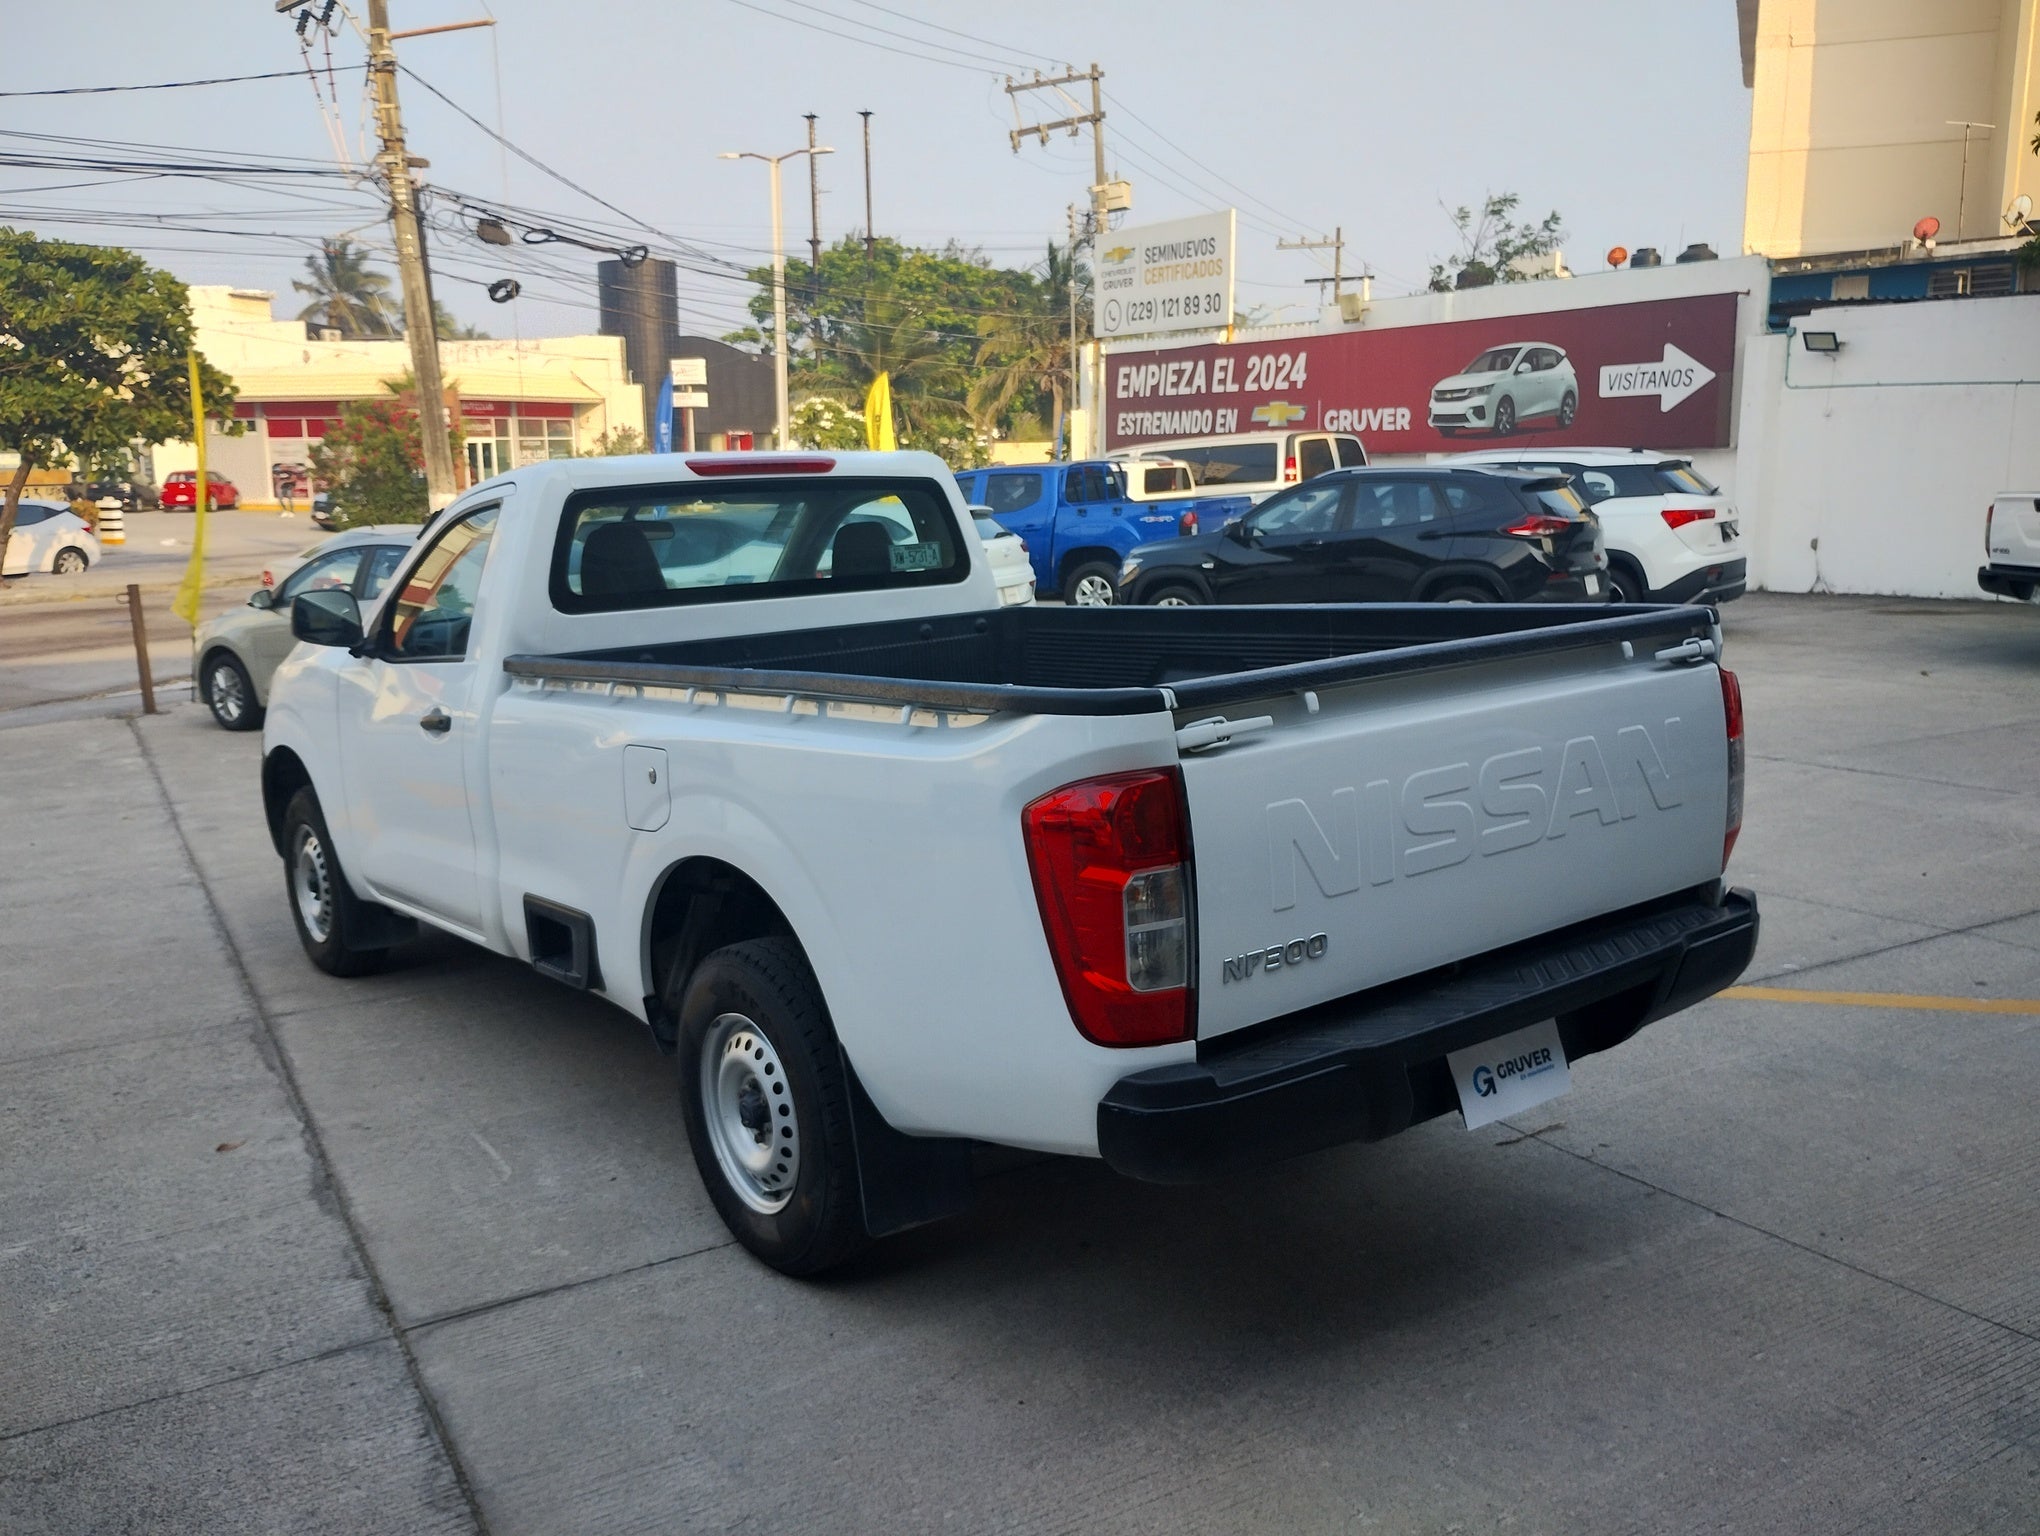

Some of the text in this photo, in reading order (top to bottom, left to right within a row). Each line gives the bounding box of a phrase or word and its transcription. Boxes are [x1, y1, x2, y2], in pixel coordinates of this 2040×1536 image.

[1144, 237, 1216, 264] SEMINUEVOS
[1101, 267, 1136, 278] CHEVROLET
[1103, 278, 1134, 291] GRUVER
[1144, 258, 1223, 285] CERTIFICADOS
[1126, 292, 1221, 326] (229) 121 89 30
[1116, 351, 1308, 399] EMPIEZA EL 2024
[1607, 366, 1695, 391] VISÍTANOS
[1116, 408, 1238, 436] ESTRENANDO EN
[1323, 406, 1412, 432] GRUVER
[1266, 716, 1683, 912] NISSAN
[1222, 931, 1328, 985] NP300
[1496, 1047, 1553, 1079] GRUVER
